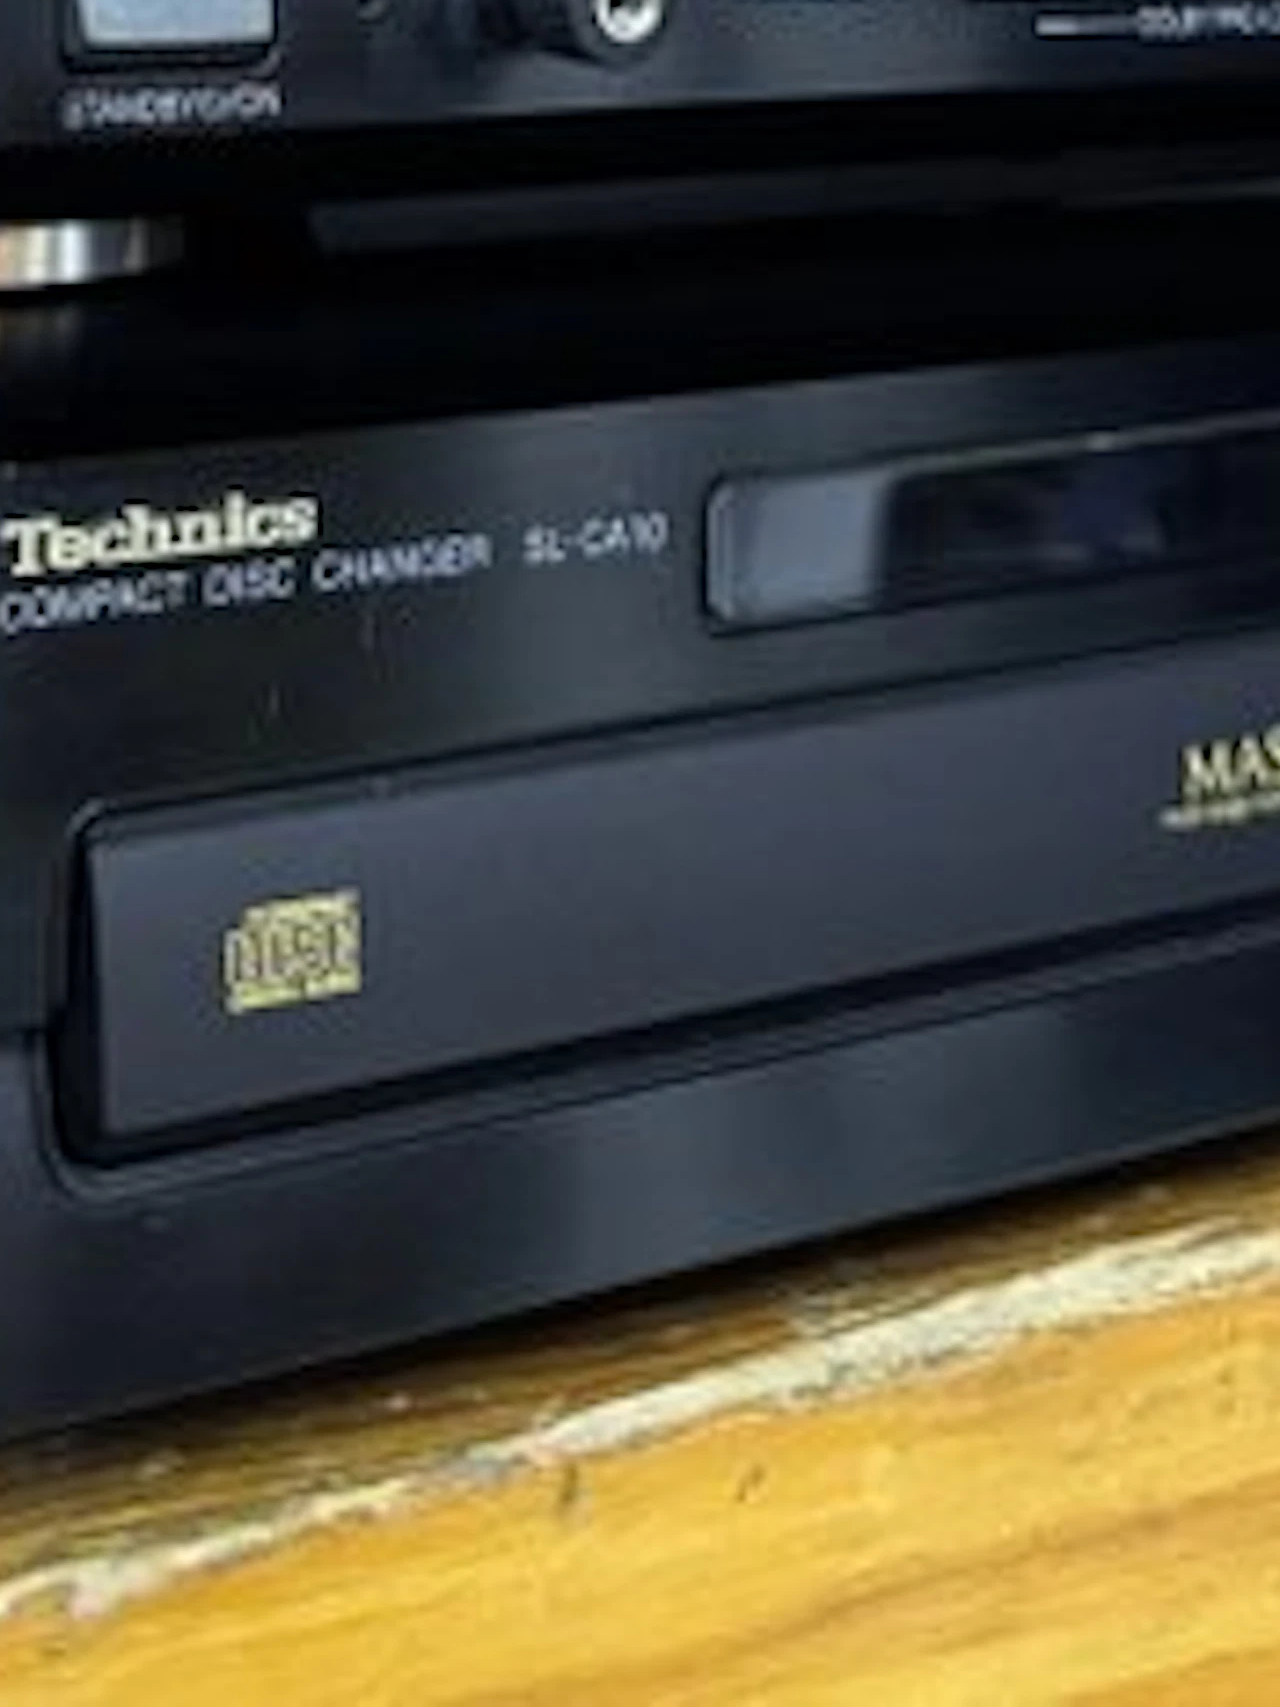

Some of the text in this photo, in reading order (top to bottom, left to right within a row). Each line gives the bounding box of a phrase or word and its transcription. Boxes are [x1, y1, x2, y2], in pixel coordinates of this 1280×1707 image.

[200, 561, 296, 609] DISC
[310, 531, 494, 589] CHANGER
[524, 511, 670, 565] SL-CA10
